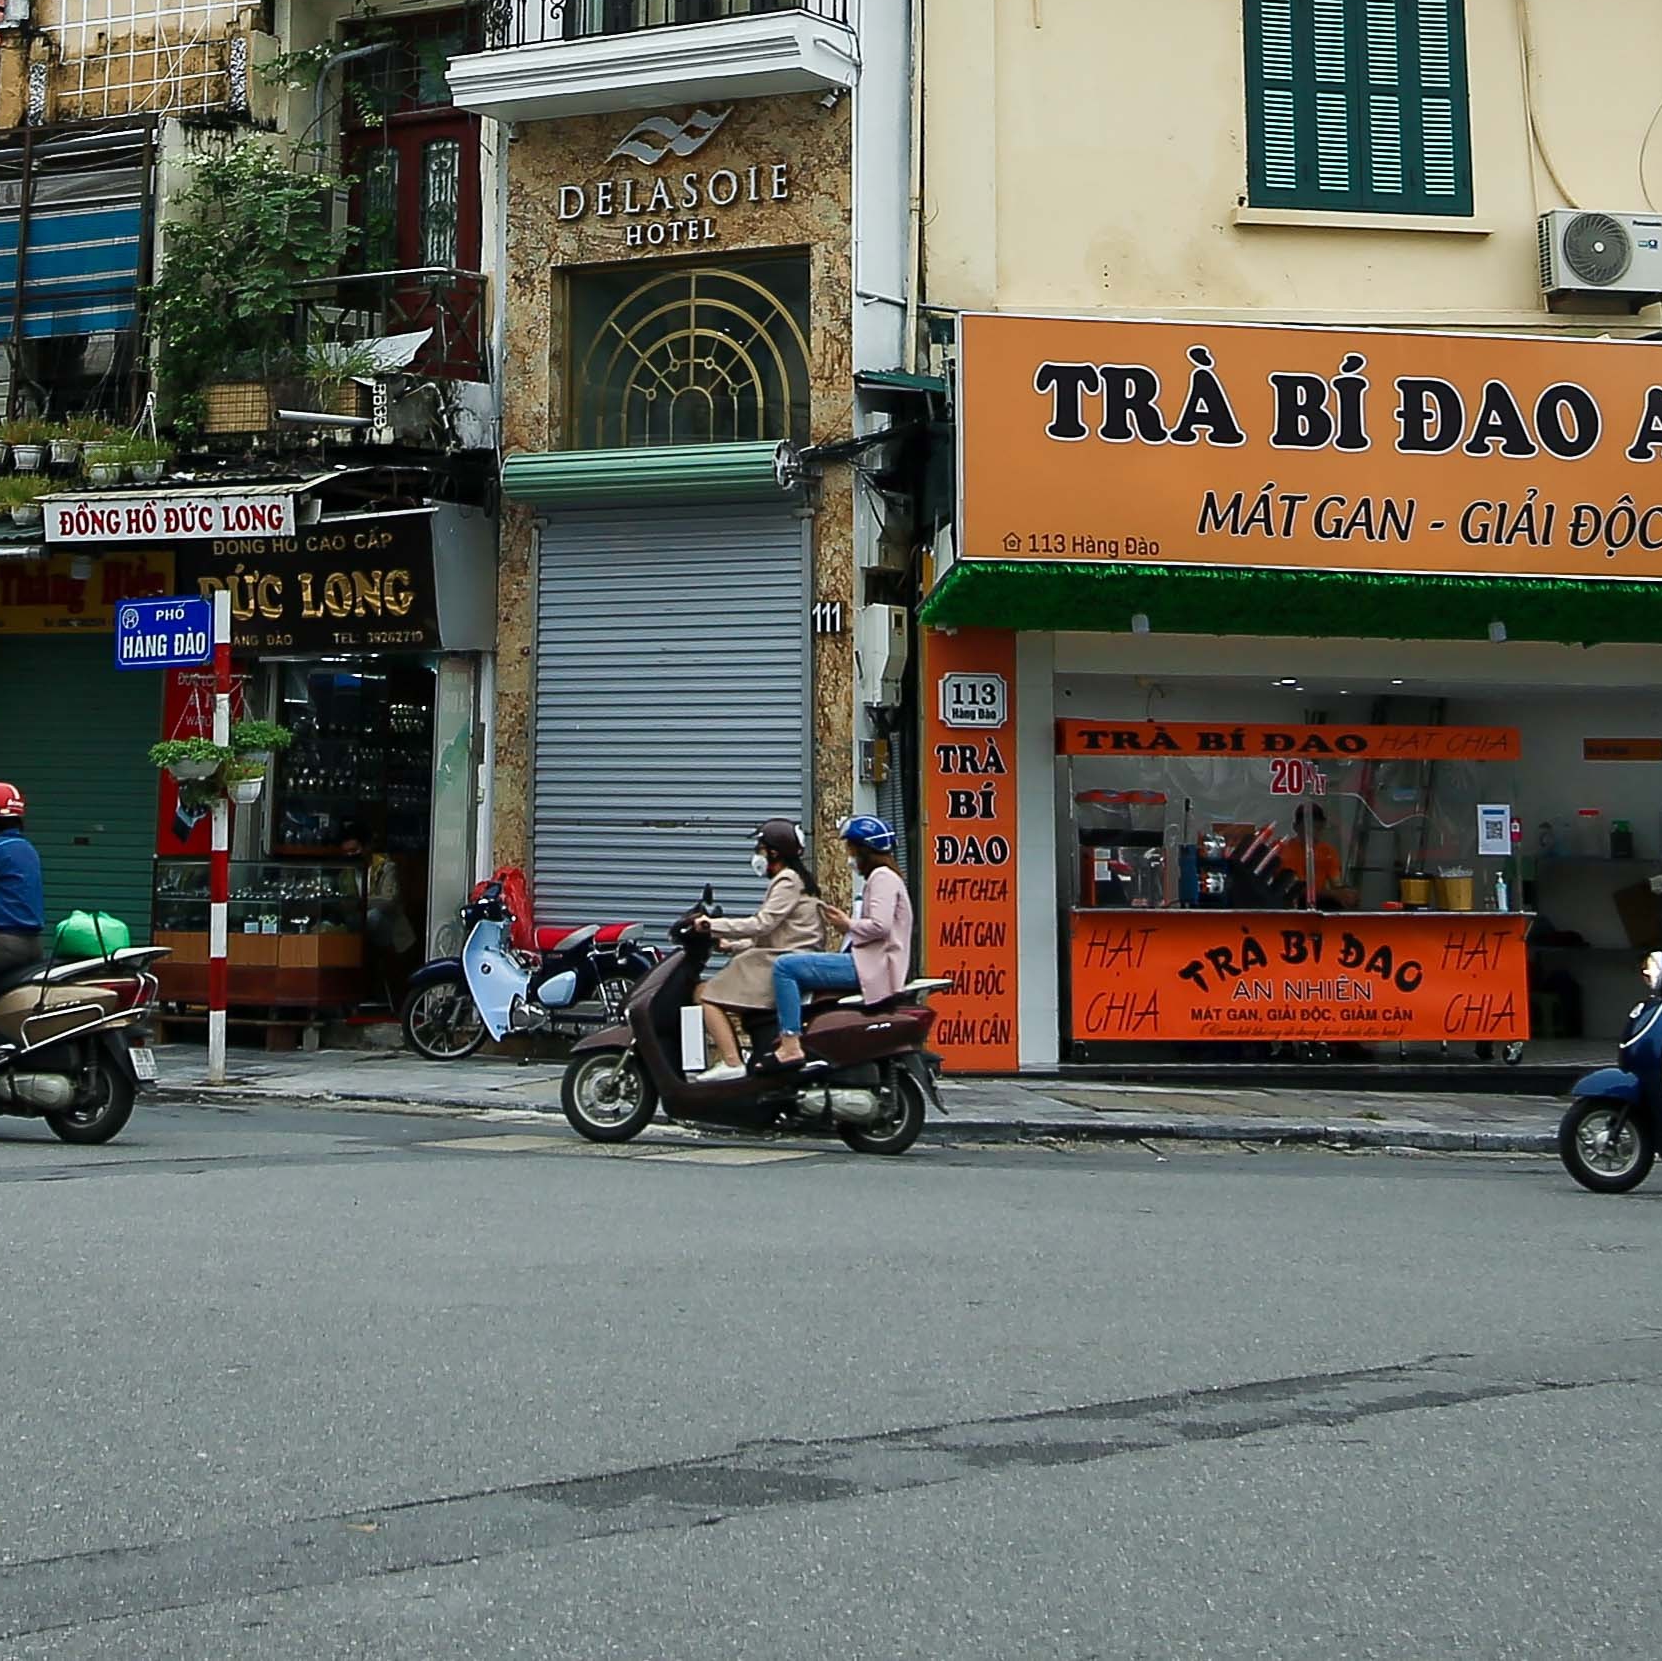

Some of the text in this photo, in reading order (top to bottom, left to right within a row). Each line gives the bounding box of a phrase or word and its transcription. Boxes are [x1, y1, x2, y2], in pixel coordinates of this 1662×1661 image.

[557, 162, 789, 220] DELASOIE
[626, 218, 716, 247] HOTEL
[1034, 345, 1246, 447] TRÀ
[1268, 352, 1372, 453] BÍ
[1392, 375, 1602, 461] ĐAO
[59, 498, 284, 536] ĐỒNG HỒ ĐỨC LONG
[1195, 481, 1309, 539] MÁT
[1313, 495, 1416, 543] GAN
[1458, 487, 1555, 547] GIẢI
[306, 534, 346, 552] CAO
[1028, 533, 1160, 558] 113 Hàng Đào
[155, 600, 185, 621] PHỐ
[297, 569, 415, 620] LONG
[812, 601, 841, 633] 111
[123, 625, 207, 659] HÀNG ĐÀO
[952, 683, 997, 705] 113
[952, 707, 997, 721] Hàng Đào
[935, 736, 1008, 775] TRÀ
[1077, 725, 1182, 752] TRÀ
[1195, 727, 1247, 752] BÍ
[1260, 732, 1369, 754] ĐAO
[946, 781, 997, 821] BÍ
[934, 834, 1010, 866] ĐAO
[937, 878, 1008, 904] HẠT CHIA
[939, 915, 1006, 947] MÁT GAN
[1178, 926, 1268, 993] TRÀ
[1337, 932, 1424, 993] ĐAO
[941, 960, 1006, 1000] GIẢI ĐỘC
[1084, 927, 1162, 1033] HẠT CHIA
[1231, 973, 1373, 1003] AN NHIÊN
[1441, 930, 1521, 1035] HẠT CHIA
[937, 1010, 1011, 1046] GIẢM CÂN
[1191, 1006, 1222, 1020] MÁT
[1267, 1005, 1296, 1020] GIẢI
[1340, 1005, 1377, 1020] GIẢM
[1382, 1006, 1413, 1021] CÂN
